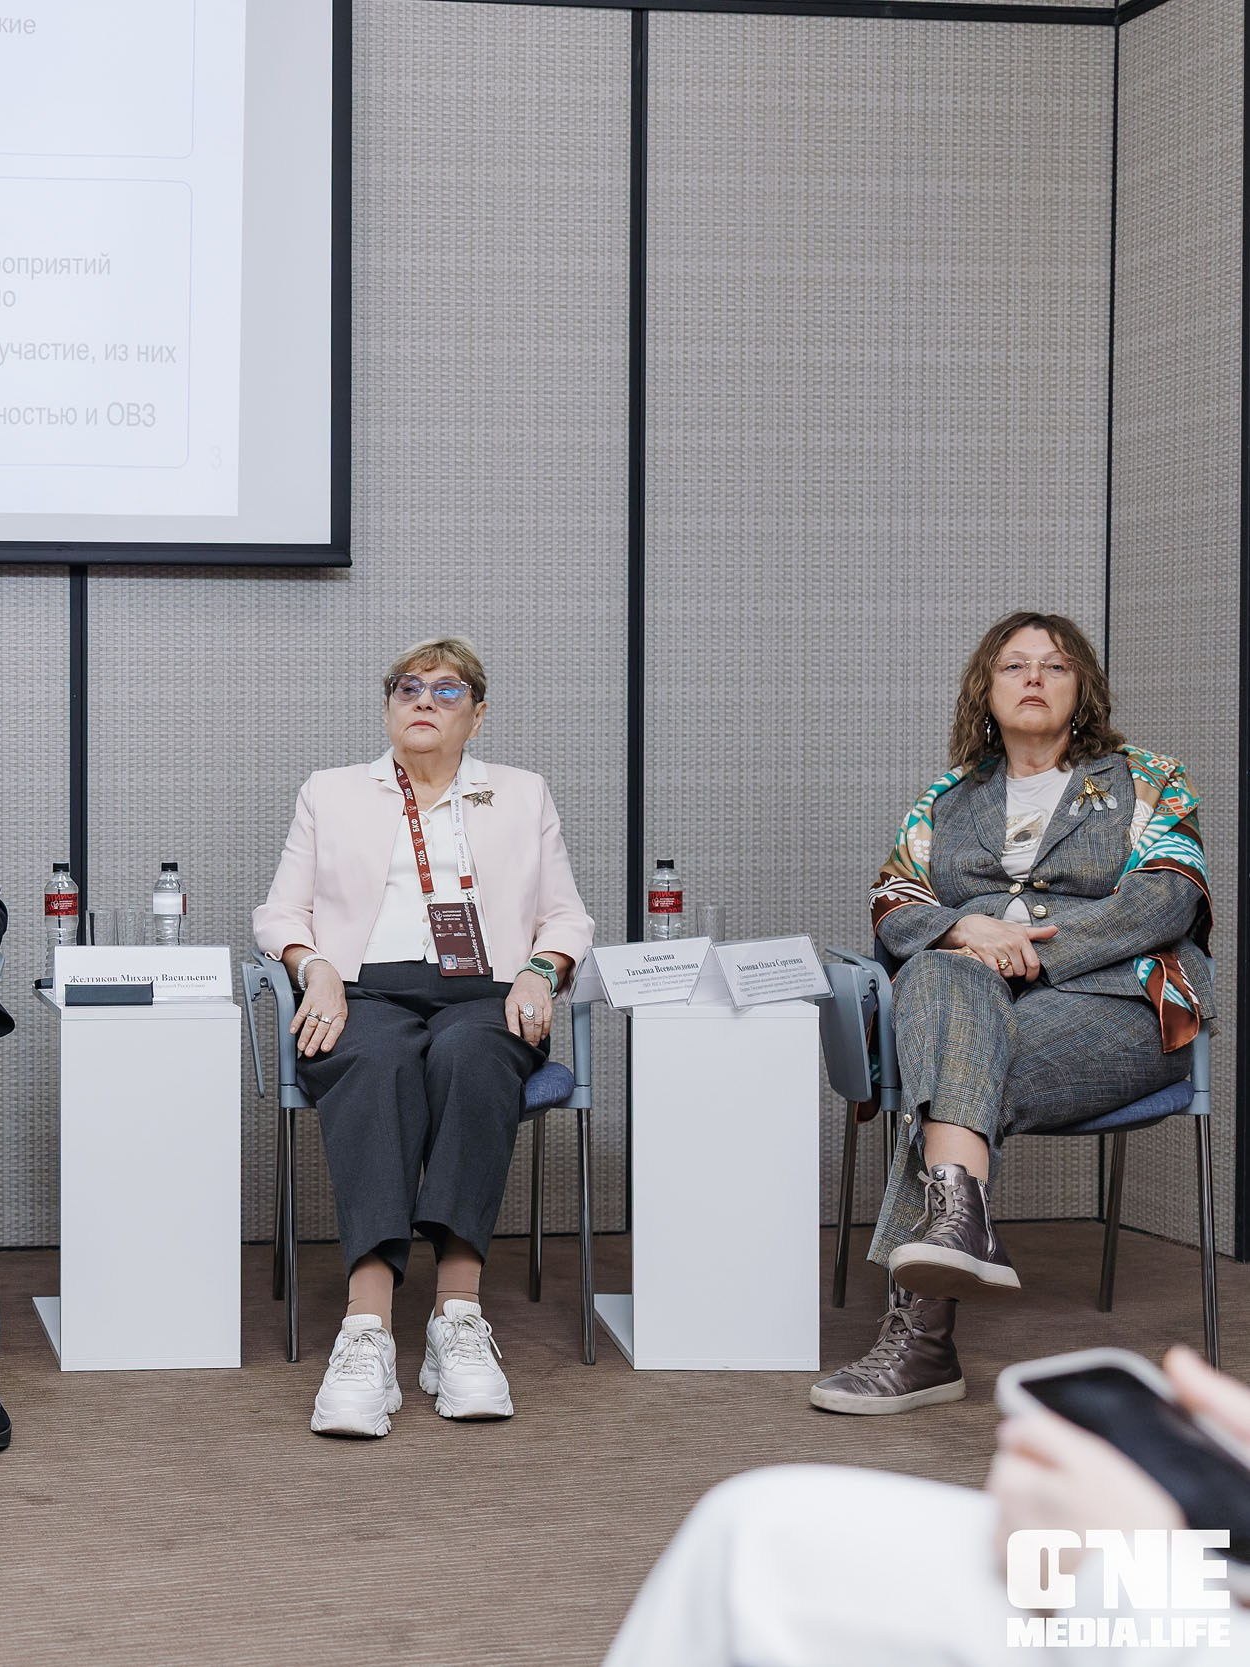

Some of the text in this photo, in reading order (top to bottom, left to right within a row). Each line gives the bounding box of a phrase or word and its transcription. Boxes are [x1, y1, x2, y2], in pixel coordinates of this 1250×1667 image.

[105, 344, 128, 361] из
[137, 344, 176, 363] них
[86, 408, 97, 425] и
[107, 402, 156, 427] ОВЗ
[411, 818, 420, 833] БКФ
[417, 850, 427, 866] 2026
[625, 962, 700, 977] Татьяна Всеволодовна
[758, 961, 777, 969] Ольга
[776, 958, 803, 968] Сергеевна
[120, 974, 159, 983] Михаил
[161, 973, 218, 982] Васильевич
